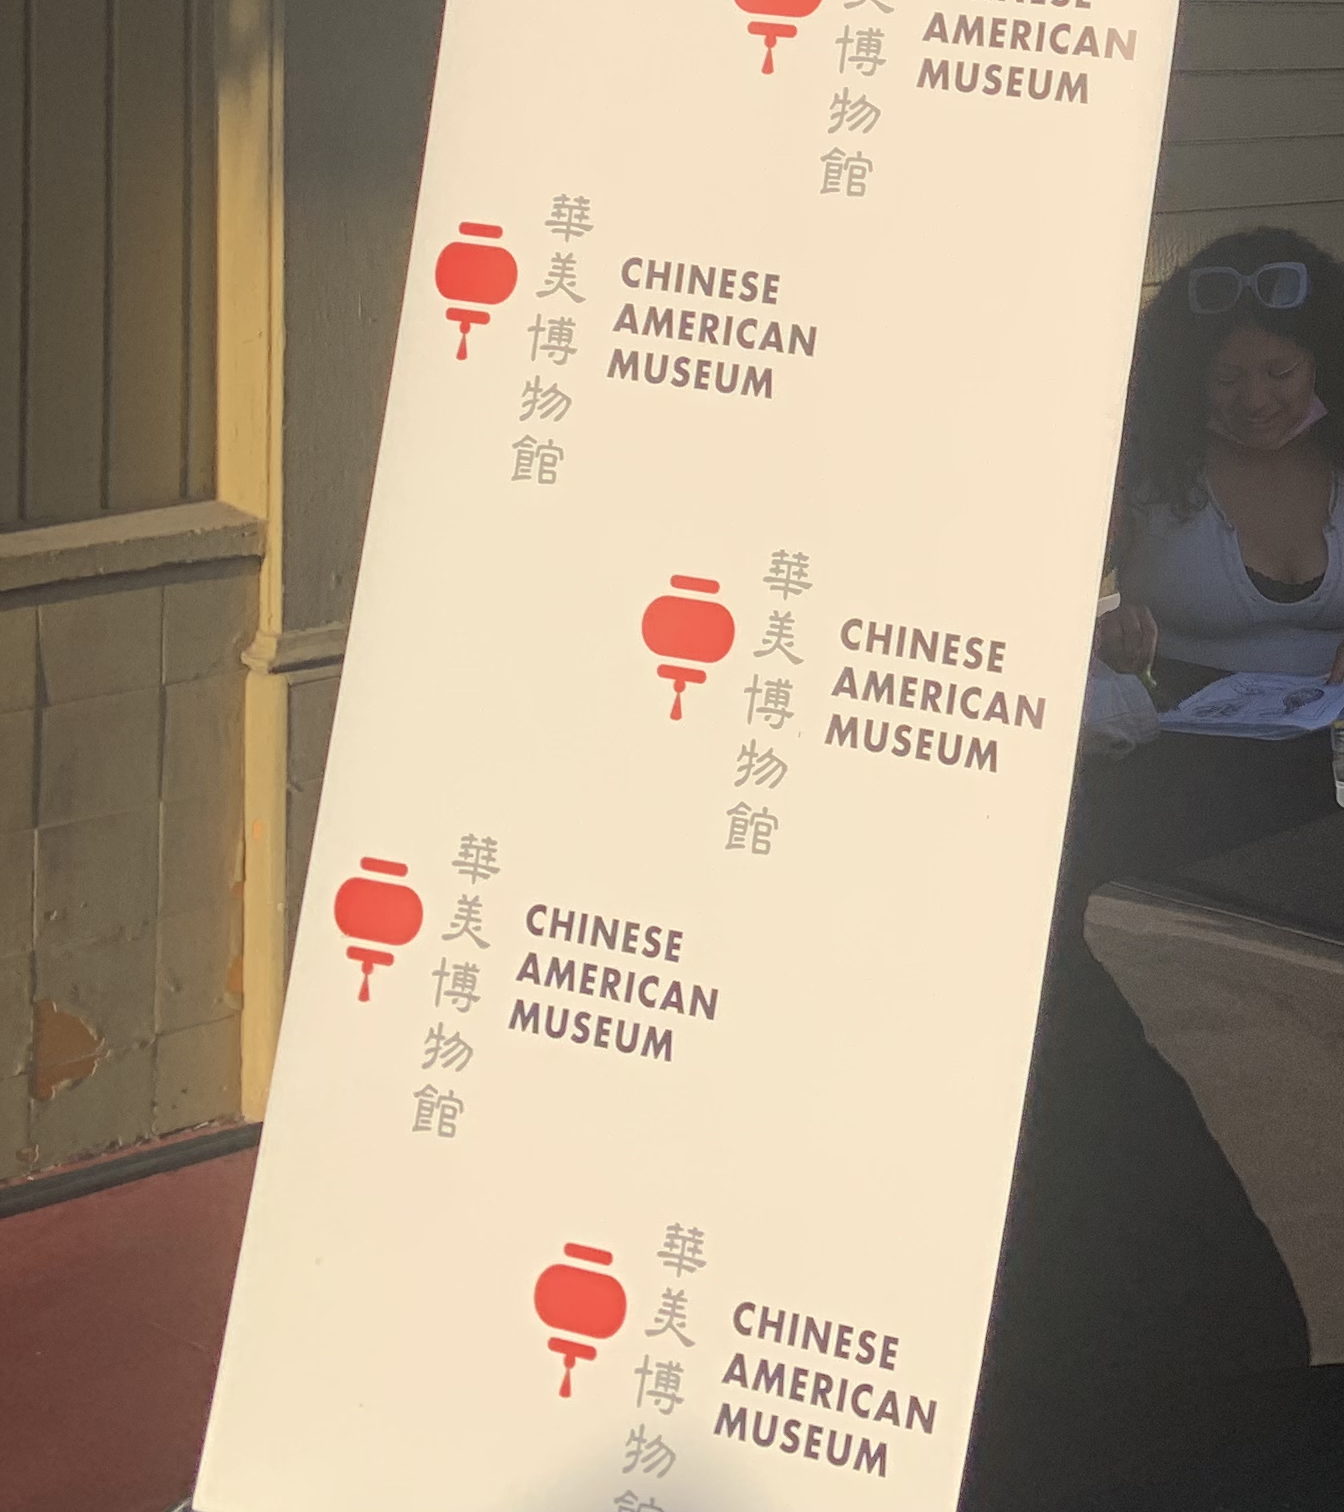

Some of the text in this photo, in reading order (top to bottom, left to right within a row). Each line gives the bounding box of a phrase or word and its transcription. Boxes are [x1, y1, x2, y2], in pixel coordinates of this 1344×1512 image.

[922, 12, 1137, 60] AMERICAN
[916, 58, 1088, 104] MUSEUM
[621, 257, 780, 305] CHINESE
[511, 194, 594, 484] 華美博物館
[612, 303, 817, 357] AMERICAN
[607, 348, 772, 399] MUSEUM
[841, 618, 1006, 673] CHINESE
[725, 549, 813, 855] 華美博物館
[831, 666, 1046, 729] AMERICAN
[824, 714, 997, 773] MUSEUM
[526, 904, 683, 963] CHINESE
[412, 834, 500, 1138] 華美博物館
[516, 952, 718, 1020] AMERICAN
[508, 999, 673, 1062] MUSEUM
[733, 1302, 899, 1371] CHINESE
[721, 1352, 937, 1434] AMERICAN
[713, 1403, 887, 1478] MUSEUM
